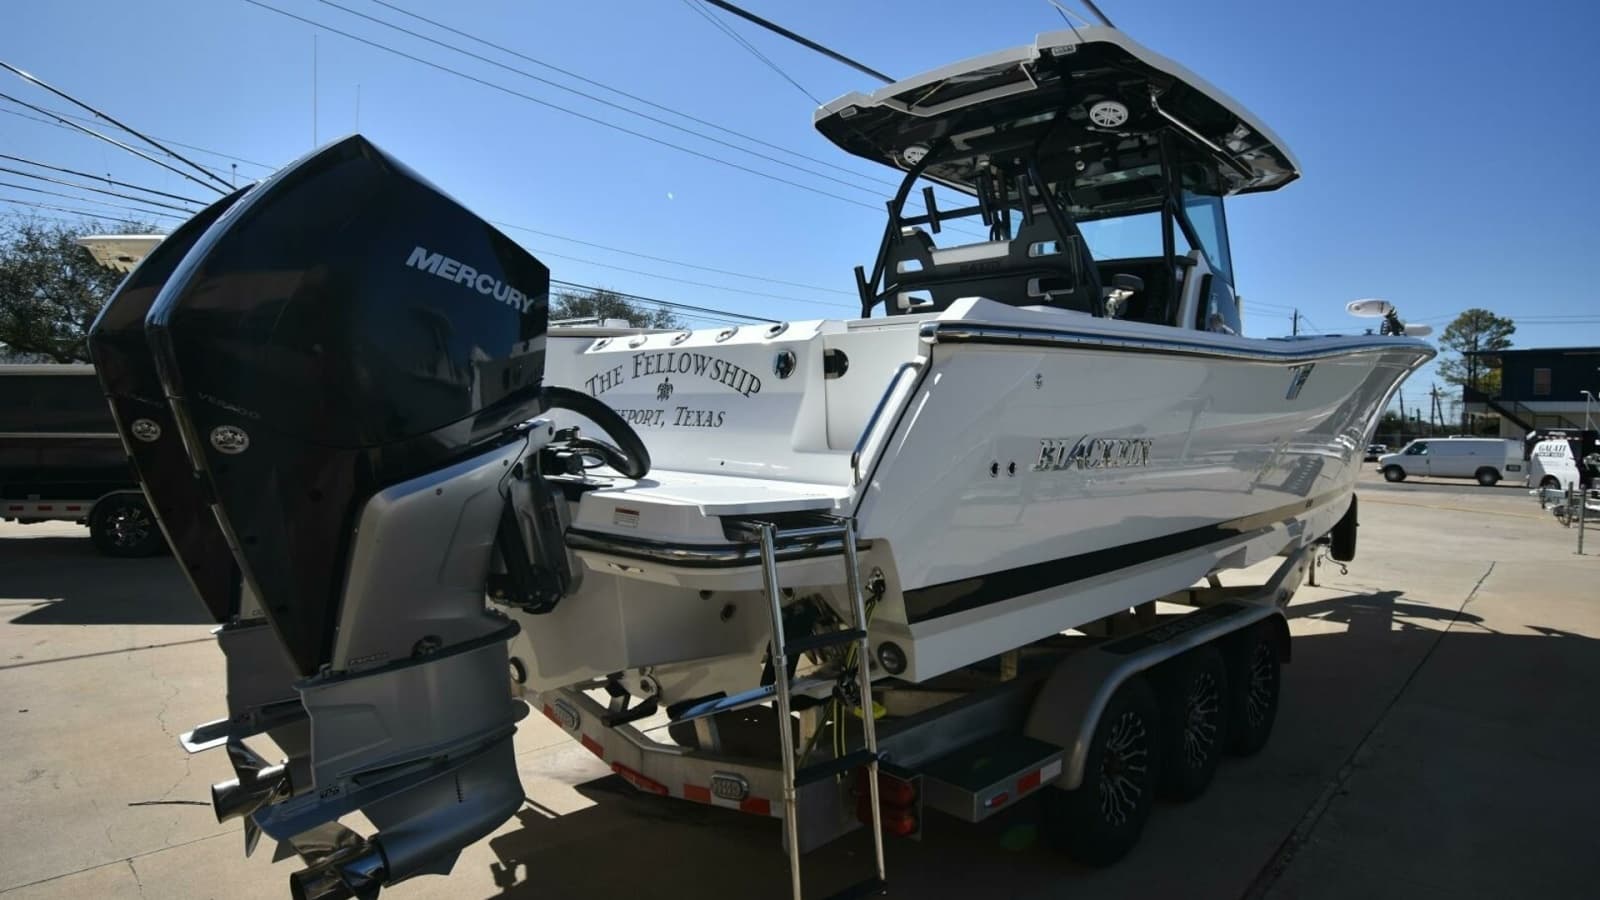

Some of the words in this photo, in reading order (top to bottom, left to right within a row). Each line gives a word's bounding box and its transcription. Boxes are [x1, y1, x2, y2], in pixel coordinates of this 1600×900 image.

[406, 246, 534, 313] MERCURY
[585, 365, 624, 397] THE
[632, 352, 762, 398] FELLOWSHIP
[673, 406, 725, 427] TEXAS
